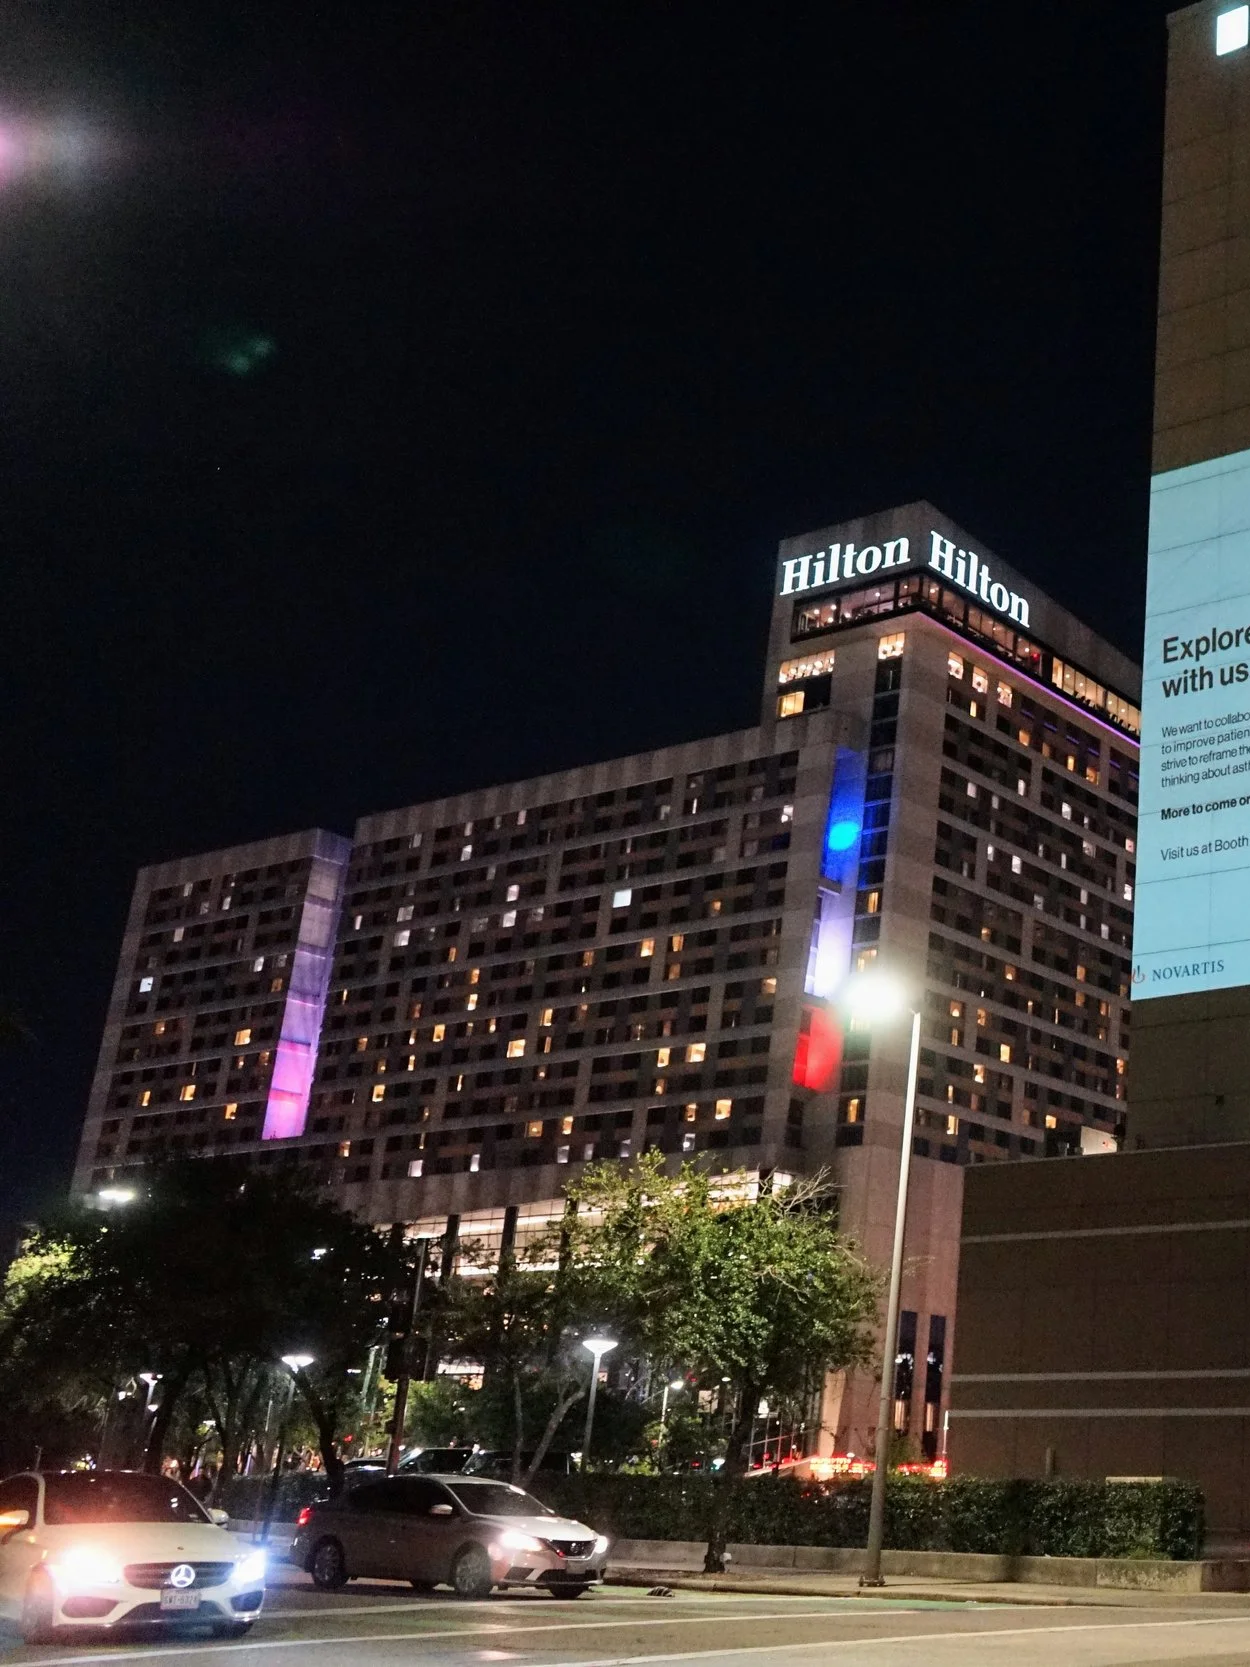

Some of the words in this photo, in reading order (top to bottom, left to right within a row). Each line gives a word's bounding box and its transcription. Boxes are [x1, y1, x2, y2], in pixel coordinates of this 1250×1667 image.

[780, 537, 910, 595] Hilton
[928, 530, 1029, 628] Hilton
[1162, 666, 1214, 698] with
[1161, 726, 1178, 738] We
[1179, 720, 1202, 735] want
[1204, 719, 1214, 729] to
[1161, 745, 1171, 755] to
[1174, 735, 1215, 752] improve
[1161, 757, 1188, 772] strive
[1188, 755, 1198, 766] to
[1200, 749, 1238, 763] reframe
[1161, 772, 1201, 788] thinking
[1202, 765, 1231, 780] about
[1161, 807, 1190, 820] More
[1192, 804, 1203, 815] to
[1205, 798, 1237, 813] come
[1160, 846, 1184, 861] Visit
[1186, 845, 1199, 857] us
[1201, 841, 1212, 854] at
[1215, 835, 1249, 852] Booth
[1152, 959, 1225, 981] NOVARTIS
